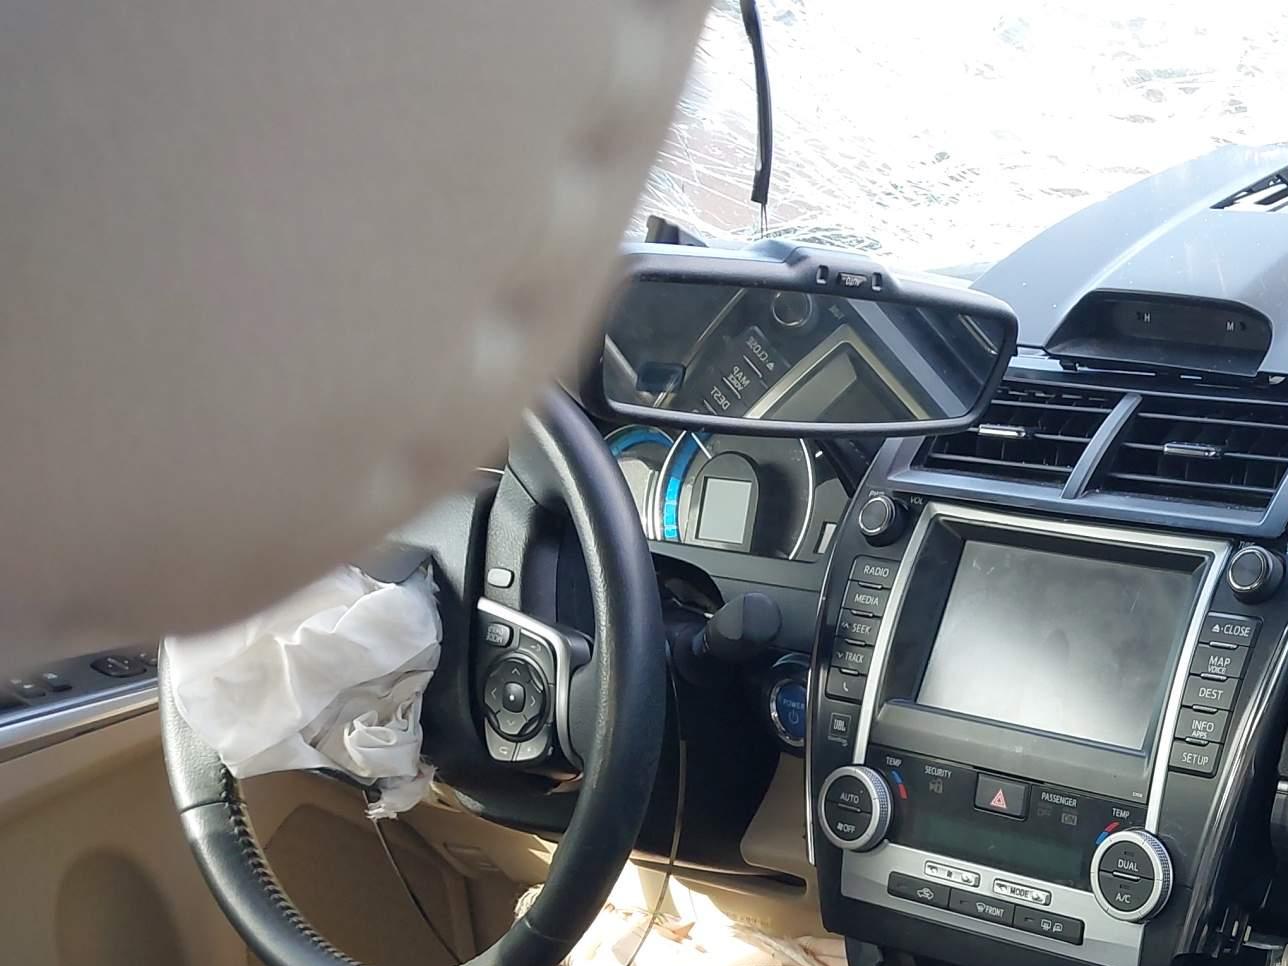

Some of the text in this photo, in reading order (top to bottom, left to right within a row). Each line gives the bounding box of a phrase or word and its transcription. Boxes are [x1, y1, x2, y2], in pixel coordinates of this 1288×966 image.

[1143, 312, 1151, 323] H
[1226, 321, 1234, 331] M
[910, 495, 923, 505] VOL
[863, 565, 890, 577] RADIO
[854, 593, 879, 606] MEDIA
[851, 623, 871, 634] SEEK
[1223, 624, 1250, 637] CLOSE
[845, 651, 865, 663] TRACK
[1208, 655, 1231, 667] MAP
[1207, 665, 1227, 674] VOICE
[1198, 687, 1224, 700] DEST
[833, 718, 846, 731] JBL
[1191, 719, 1214, 732] INFO
[1191, 730, 1208, 739] APPS
[886, 756, 902, 767] TEMP
[924, 765, 952, 778] SECURITY
[840, 791, 860, 804] AUTO
[1041, 792, 1077, 807] PASSENGER
[1112, 807, 1130, 819] TEMP
[843, 823, 856, 834] OFF
[1117, 859, 1139, 871] DUAL
[1009, 886, 1029, 898] MODE
[1115, 892, 1131, 903] A/C
[984, 905, 1004, 918] FRONT
